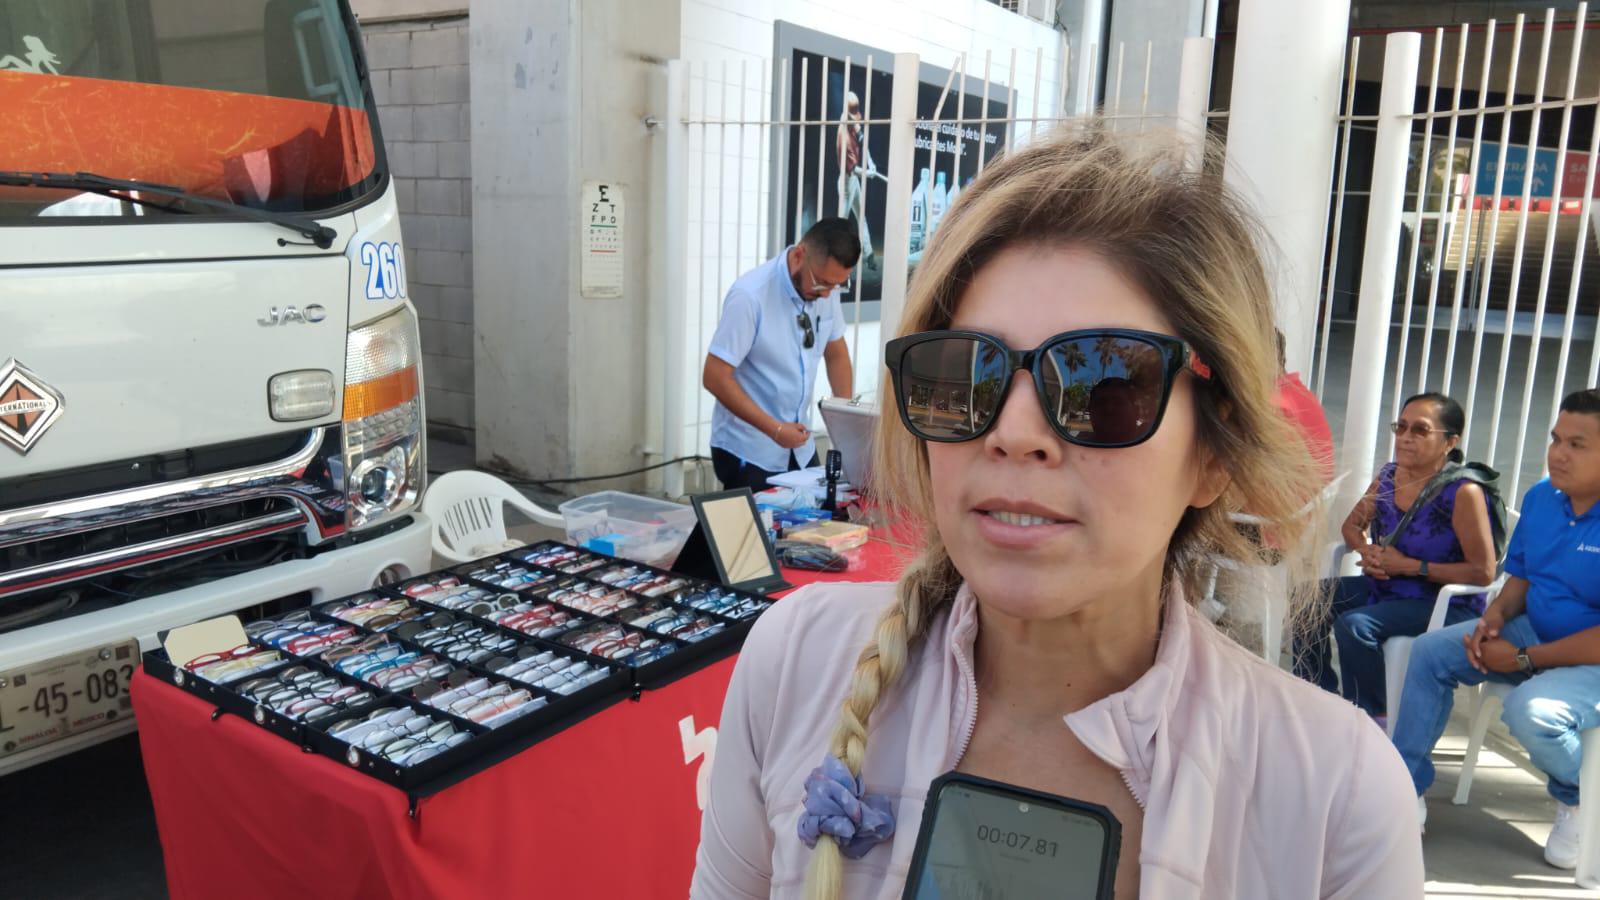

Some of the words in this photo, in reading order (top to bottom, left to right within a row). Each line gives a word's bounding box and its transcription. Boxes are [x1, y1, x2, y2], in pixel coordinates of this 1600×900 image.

[942, 121, 965, 138] cuidao
[965, 127, 974, 140] de
[599, 185, 609, 202] E
[592, 203, 599, 212] Z
[609, 204, 616, 213] T
[256, 304, 327, 327] JAC
[977, 824, 1059, 857] 00:07.81
